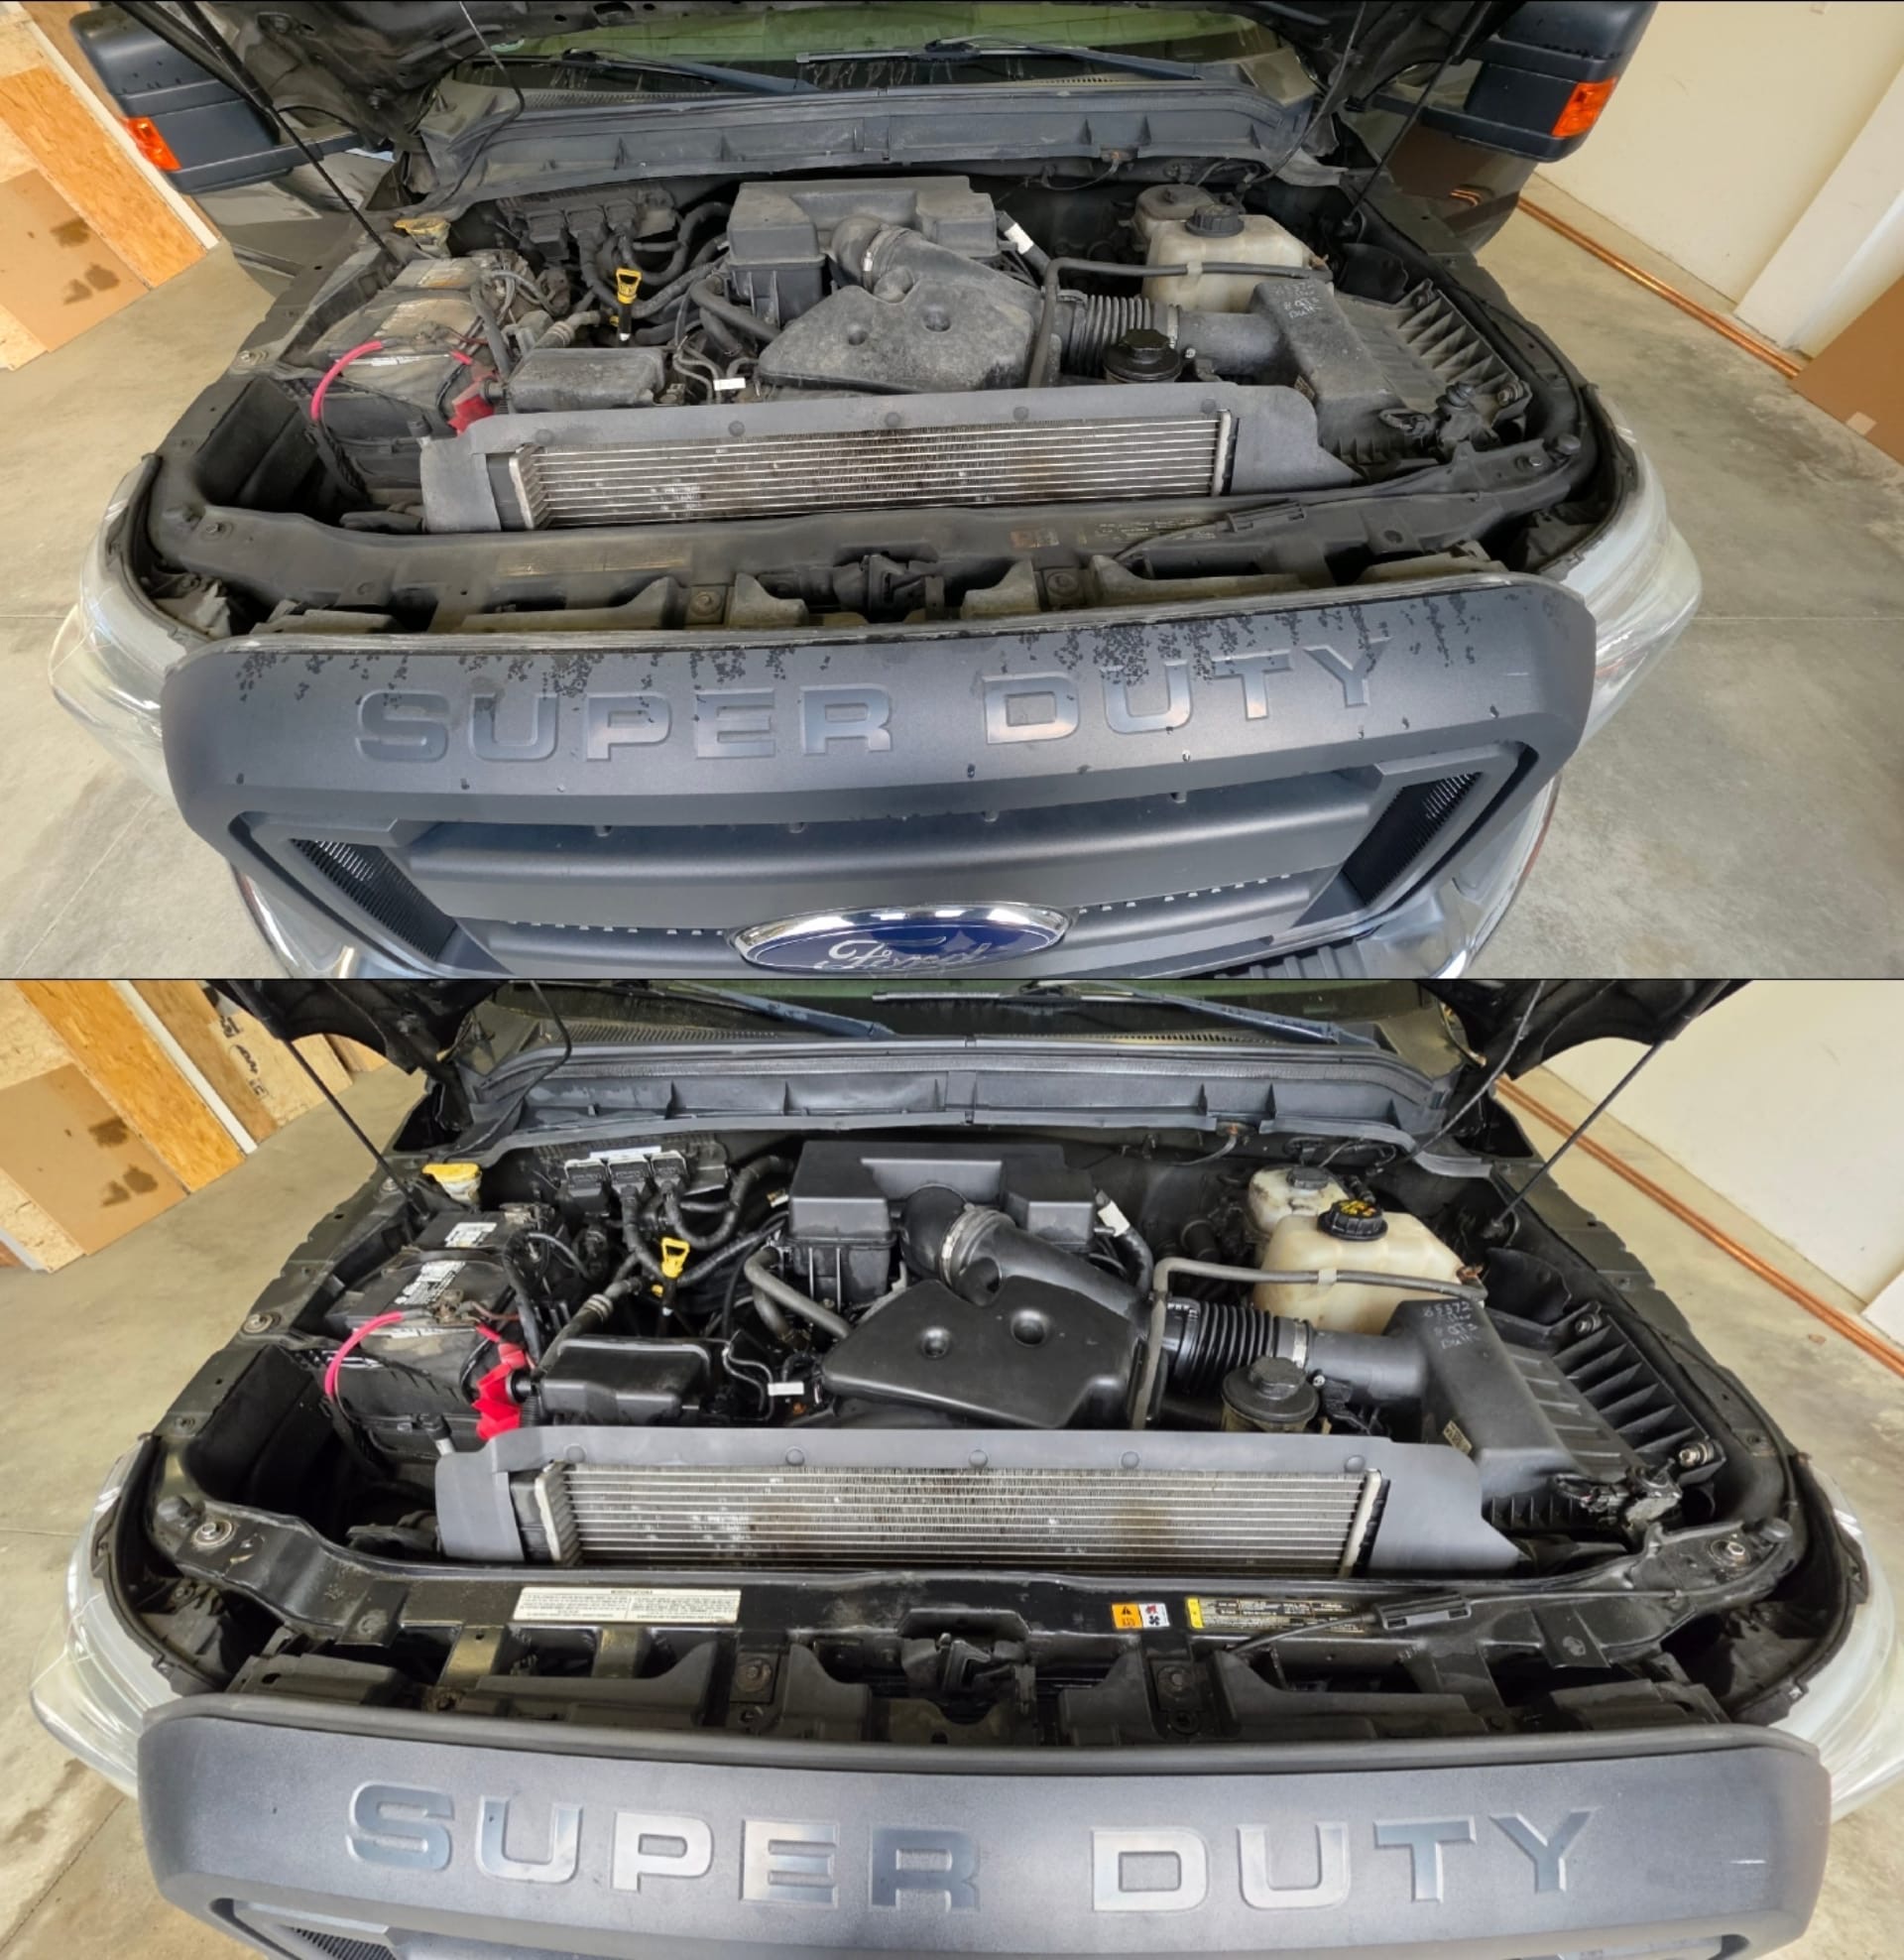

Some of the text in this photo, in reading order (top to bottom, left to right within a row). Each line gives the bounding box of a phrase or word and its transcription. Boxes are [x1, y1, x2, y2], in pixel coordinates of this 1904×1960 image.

[355, 637, 1391, 763] SUPER DUTY
[814, 934, 992, 971] Ford
[345, 1780, 1601, 1913] SUPER DUTY
